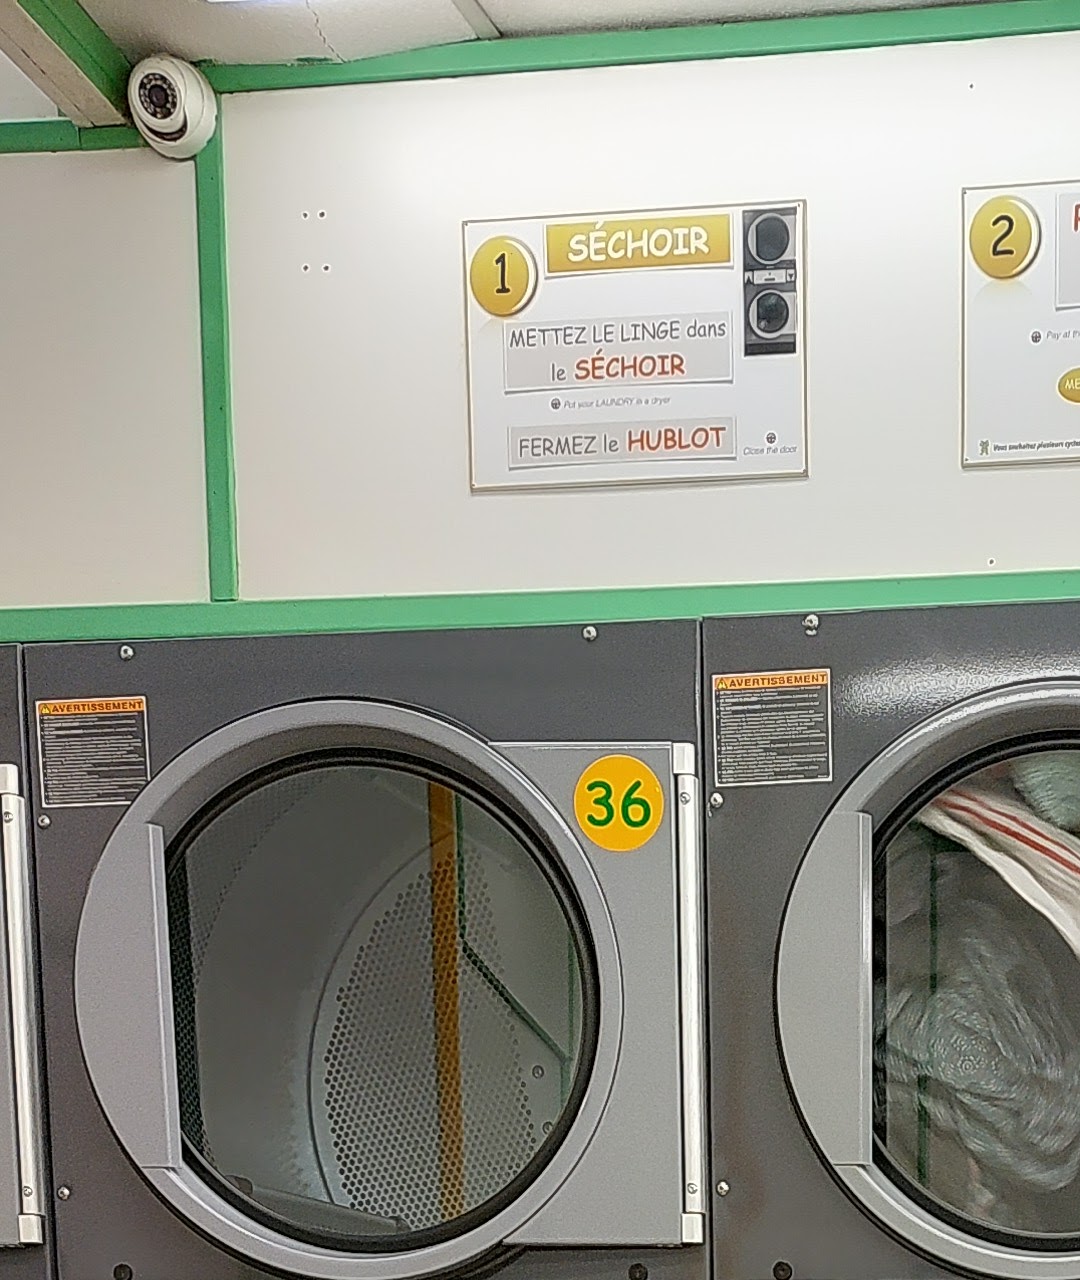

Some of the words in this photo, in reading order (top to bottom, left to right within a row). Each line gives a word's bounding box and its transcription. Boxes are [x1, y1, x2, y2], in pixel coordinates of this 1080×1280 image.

[567, 219, 710, 263] SÉCHOIR
[991, 214, 1015, 257] 2
[494, 253, 511, 294] 1
[509, 326, 587, 349] METTEZ
[592, 324, 615, 344] LE
[620, 321, 681, 343] LINGE
[686, 319, 727, 339] dans
[551, 363, 567, 383] le
[574, 348, 686, 381] SÉCHOIR
[519, 437, 597, 458] FERMEZ
[603, 433, 619, 453] le
[626, 427, 726, 452] HUBLOT
[729, 674, 827, 688] AVERTISSEMENT
[52, 701, 143, 713] AVERTISSEMENT
[586, 779, 651, 828] 36
